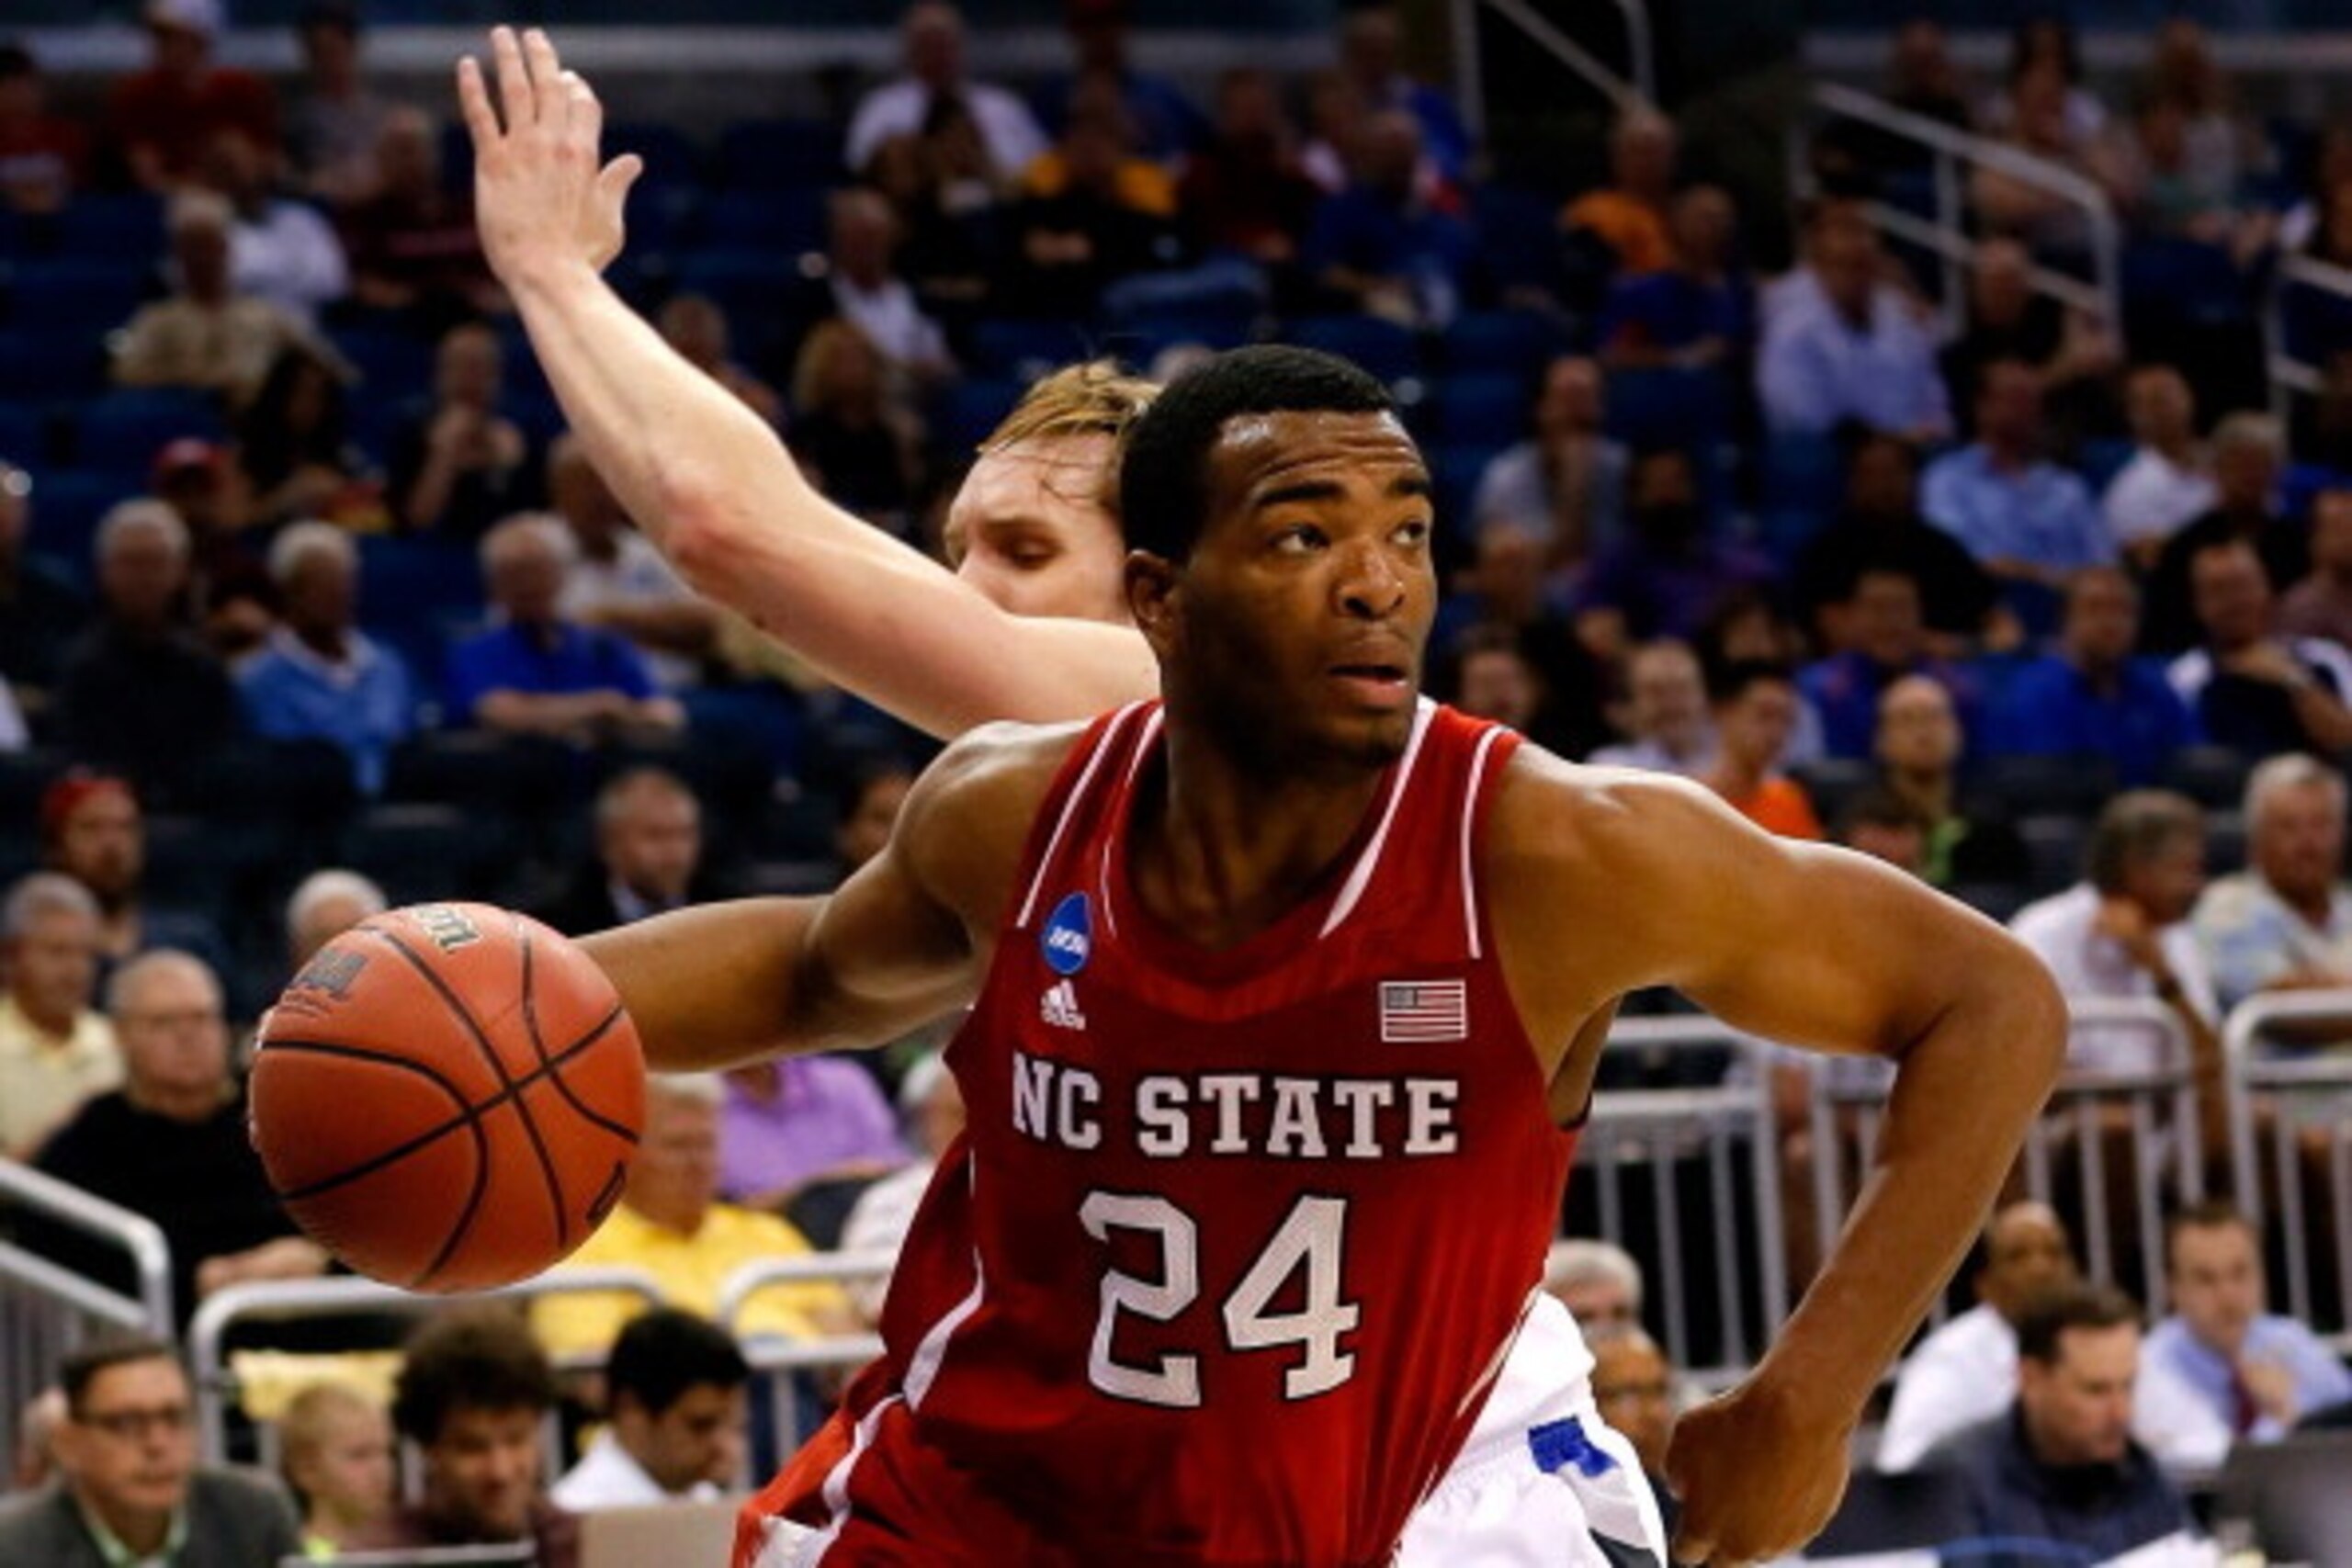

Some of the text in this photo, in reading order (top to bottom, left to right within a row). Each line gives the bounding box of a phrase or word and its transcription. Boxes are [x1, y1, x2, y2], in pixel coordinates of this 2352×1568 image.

[1012, 1053, 1459, 1157] NC STATE
[1078, 1190, 1360, 1407] 24
